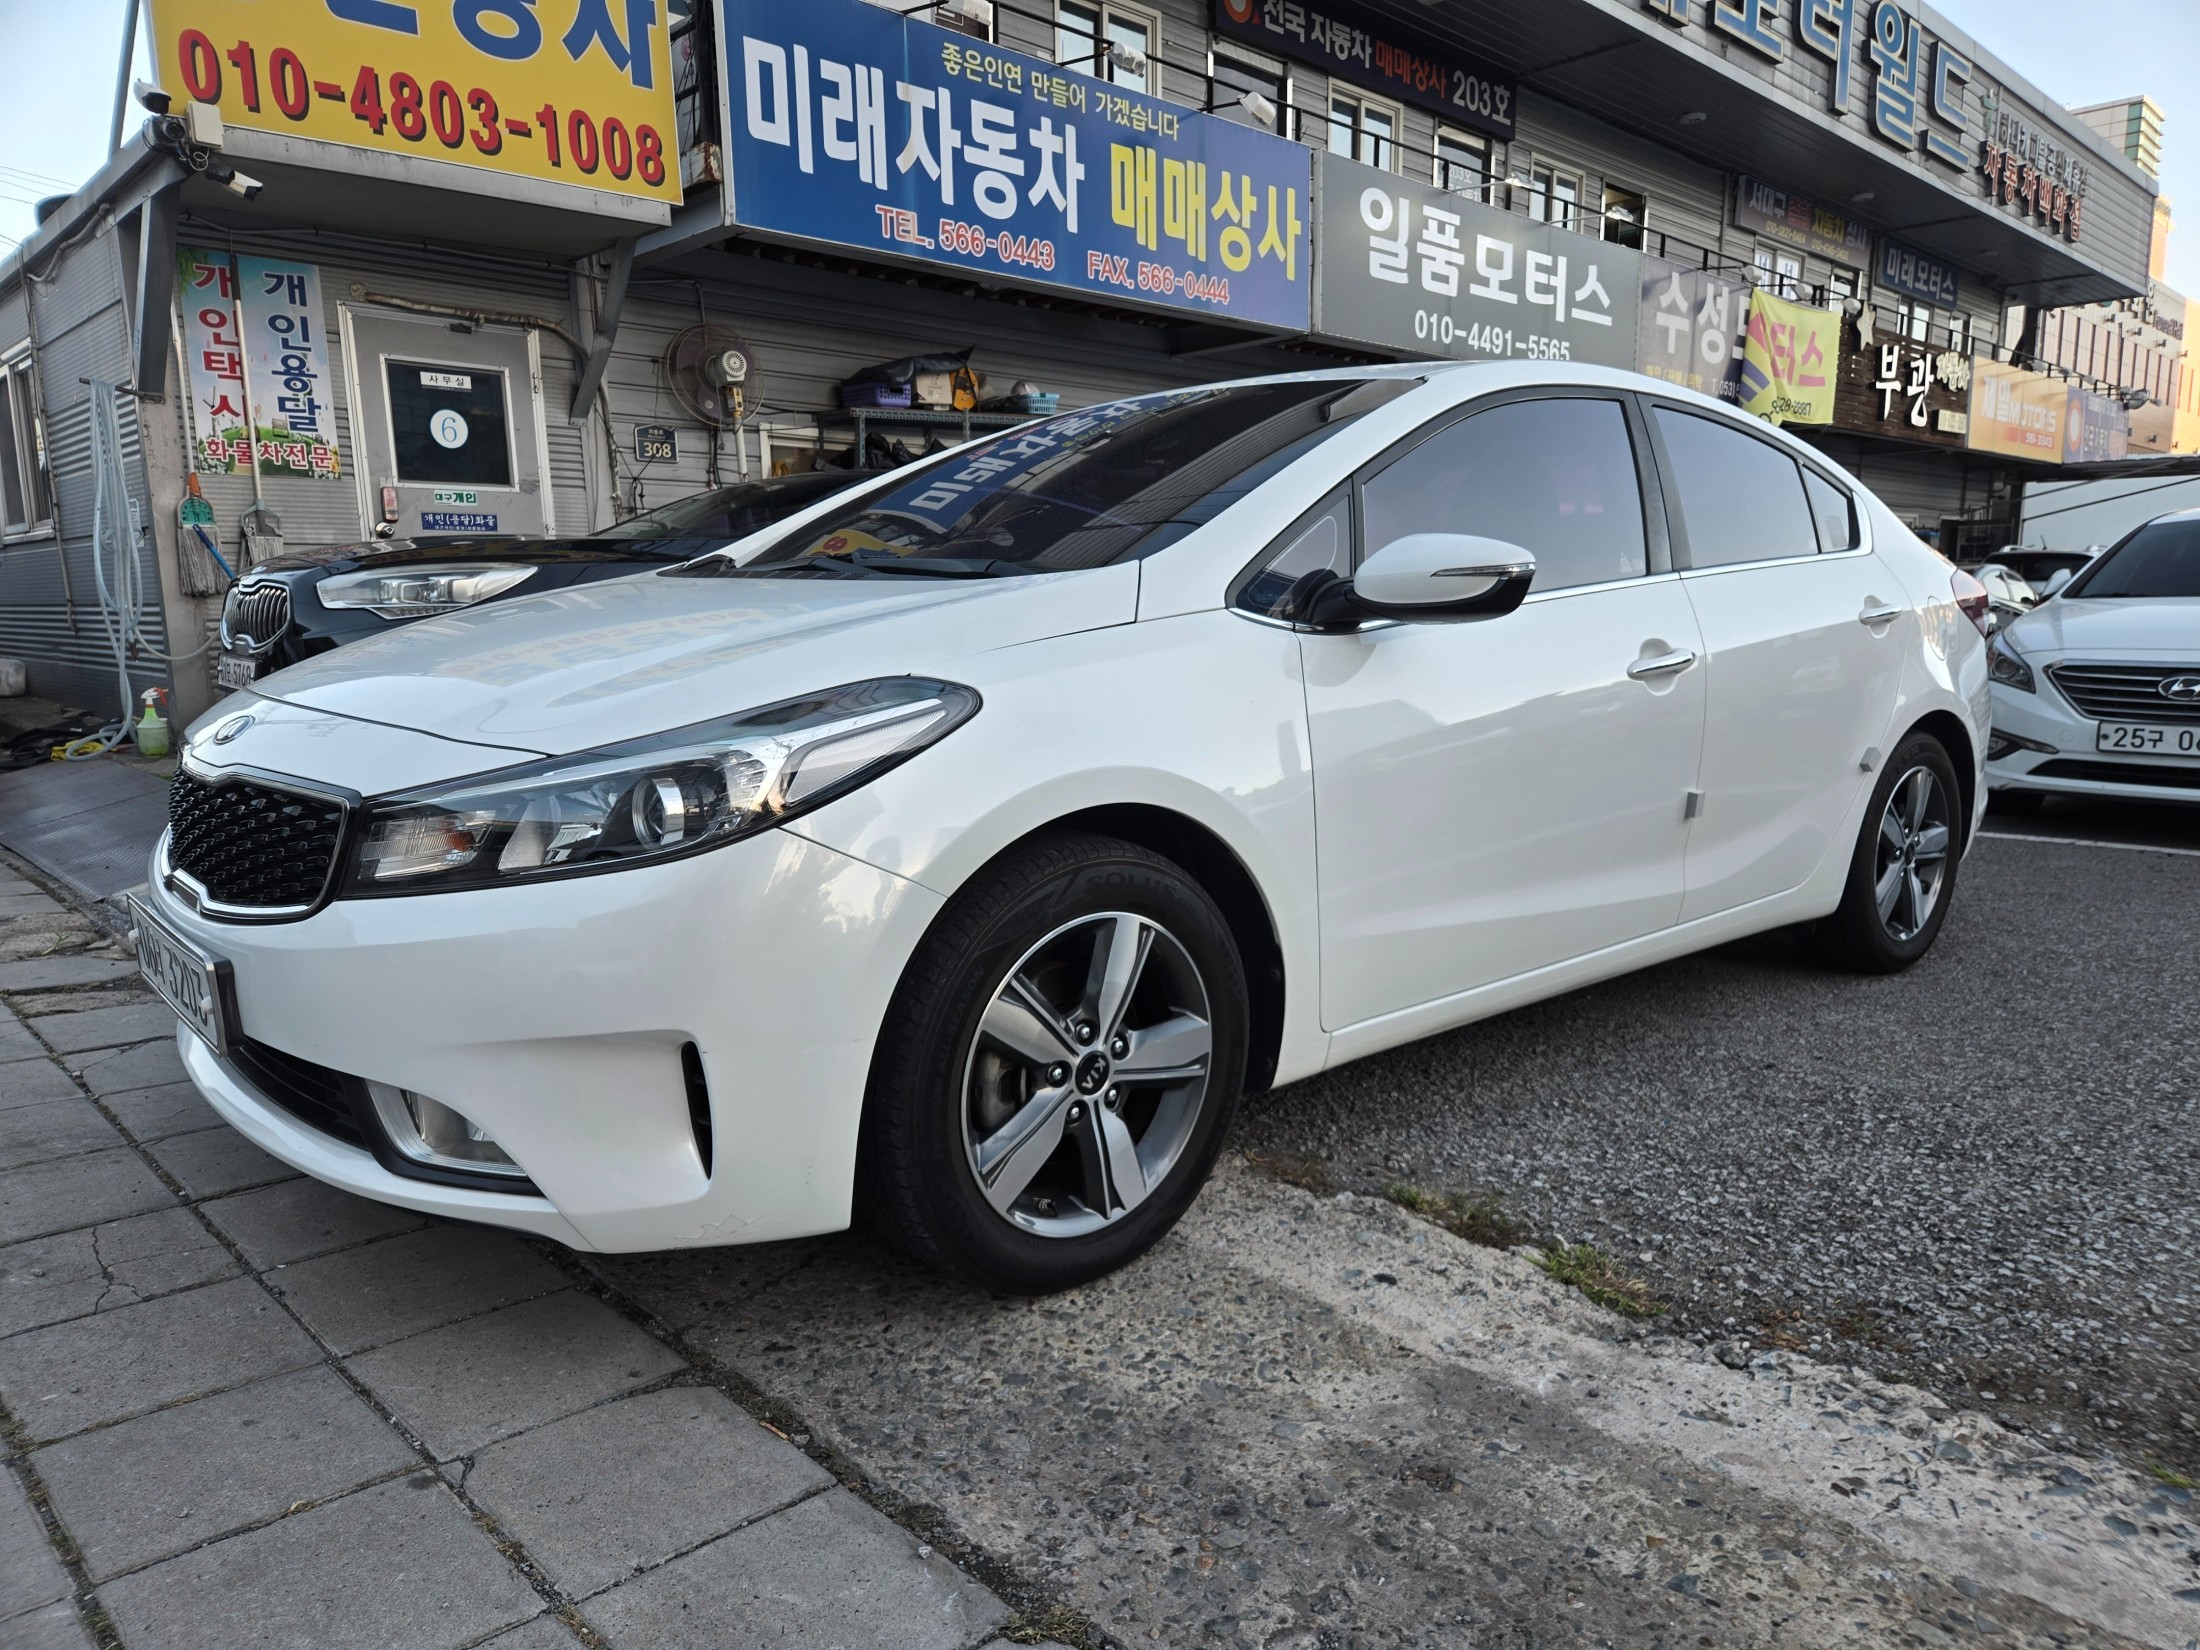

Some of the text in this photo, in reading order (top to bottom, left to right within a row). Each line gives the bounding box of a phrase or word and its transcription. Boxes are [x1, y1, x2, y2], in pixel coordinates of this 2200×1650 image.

[941, 42, 1180, 142] 좋은인연 만들어 가겠습니다
[1263, 0, 1511, 126] 전국 자동차 매매상사 203호
[178, 28, 666, 187] 010-4803-1008
[742, 35, 1085, 234] 미래자동차
[1110, 142, 1302, 281] 매매상사
[1983, 141, 2082, 242] 자동차백화점
[875, 204, 1230, 305] TEL. 566-0443 FAX. 566-0444
[1360, 187, 1613, 327] 일품모터스
[1750, 182, 1787, 219] 서대구
[1812, 208, 1845, 244] 자동차
[1846, 223, 1867, 250] 상사
[1886, 246, 1954, 302] 미래모터스
[263, 271, 322, 434] 개인용달
[1414, 309, 1570, 361] 010-4491-5565
[429, 375, 464, 387] 사무실
[1875, 343, 1935, 428] 부광
[441, 416, 457, 443] 6
[643, 442, 672, 458] 308
[2113, 726, 2200, 752] 25구 0
[1081, 1056, 1107, 1089] KIA
